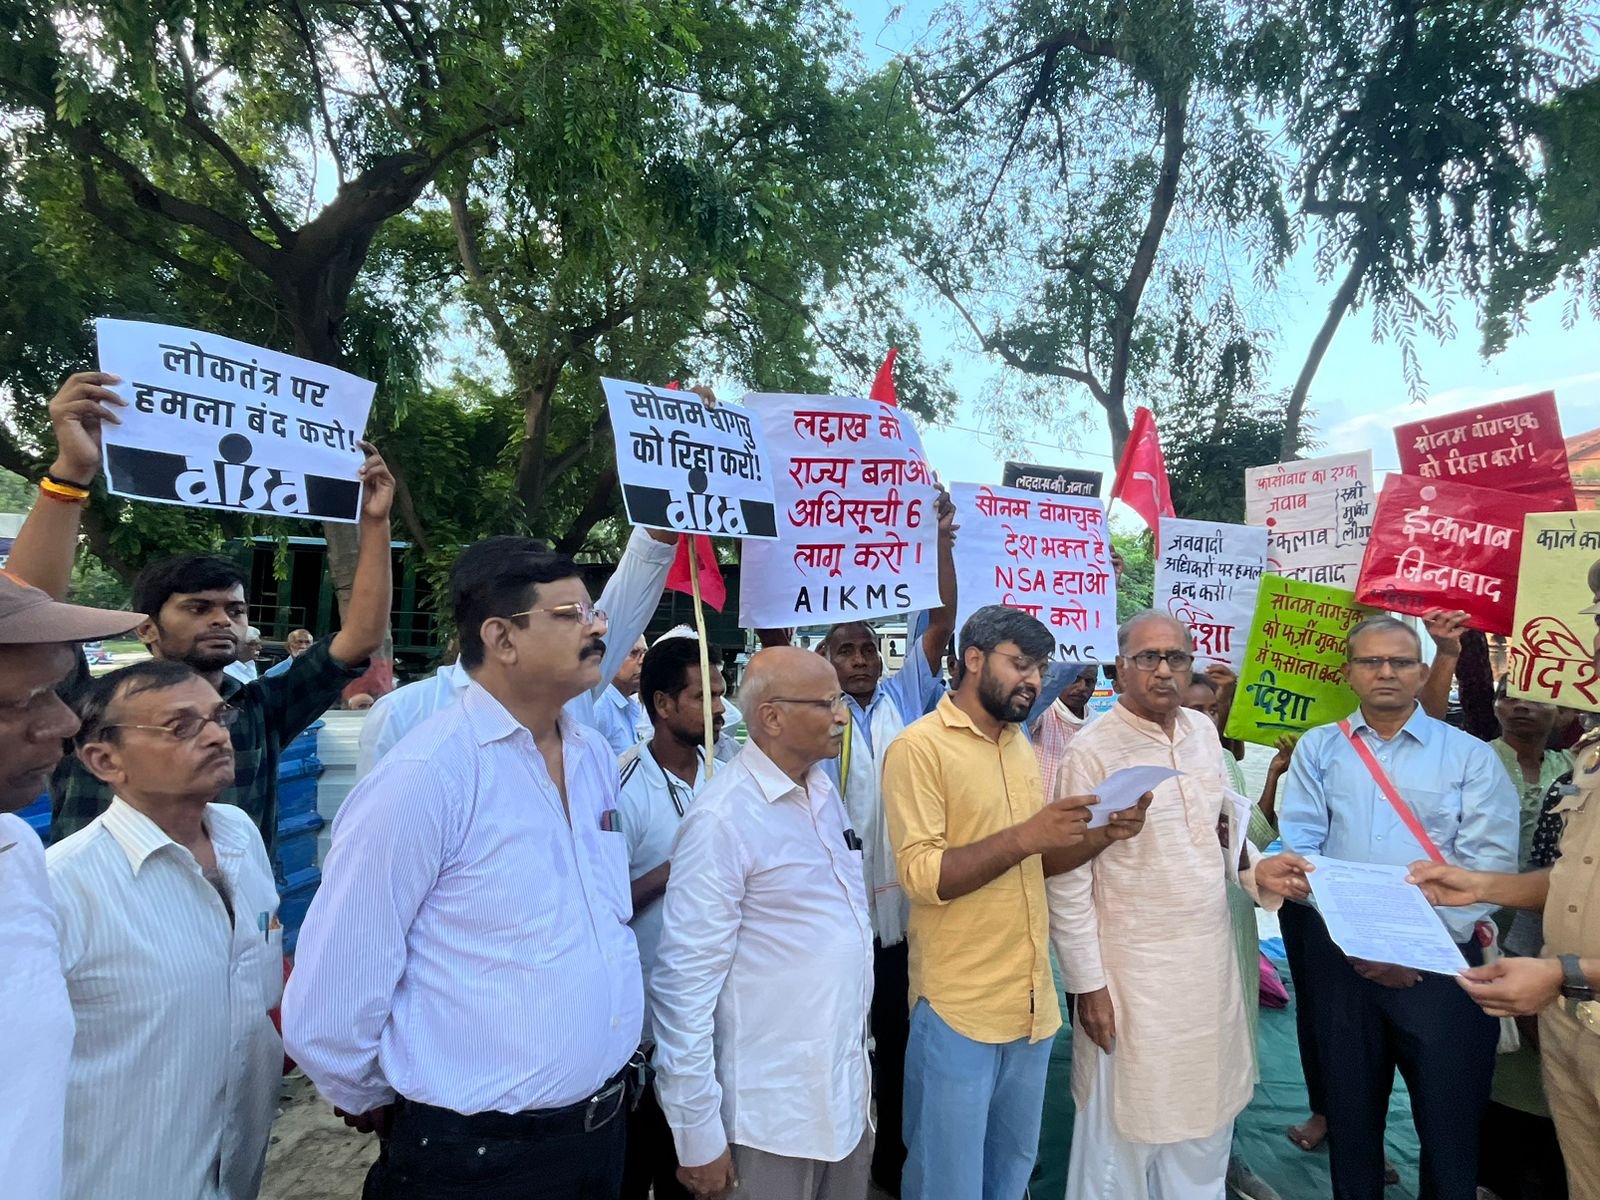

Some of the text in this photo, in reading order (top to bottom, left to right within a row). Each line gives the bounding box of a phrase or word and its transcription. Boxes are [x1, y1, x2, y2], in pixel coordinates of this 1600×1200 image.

[158, 340, 330, 408] लोकतंत्र पर
[132, 381, 357, 453] हमला बंद करो!
[624, 386, 707, 428] सोनम
[793, 405, 903, 448] लद्दाख को
[1472, 414, 1540, 437] वांगचुक
[629, 425, 763, 482] को रिहा करो!
[789, 448, 932, 489] राज्य बनाओ
[1418, 454, 1442, 479] को
[1445, 448, 1488, 476] रिहा
[1065, 481, 1094, 496] जनता
[1312, 469, 1326, 484] का
[788, 487, 922, 534] अधिसूची 6
[975, 486, 1103, 531] सोनम वांगचुक
[1266, 492, 1311, 514] जवाब
[1001, 524, 1037, 563] देश
[1041, 535, 1089, 560] भक्त
[1168, 529, 1224, 555] जनवादी
[1536, 518, 1577, 550] काले
[995, 565, 1046, 593] NSA
[1052, 563, 1109, 595] हटाओ
[1218, 563, 1235, 577] पर
[1235, 555, 1264, 580] हमले
[793, 583, 912, 614] AIKMS
[1172, 581, 1197, 600] बन्द
[1270, 583, 1316, 616] सोनम
[1263, 613, 1281, 639] को
[1048, 643, 1100, 664] MS
[1256, 640, 1272, 664] में
[1246, 670, 1316, 722] दिशा
